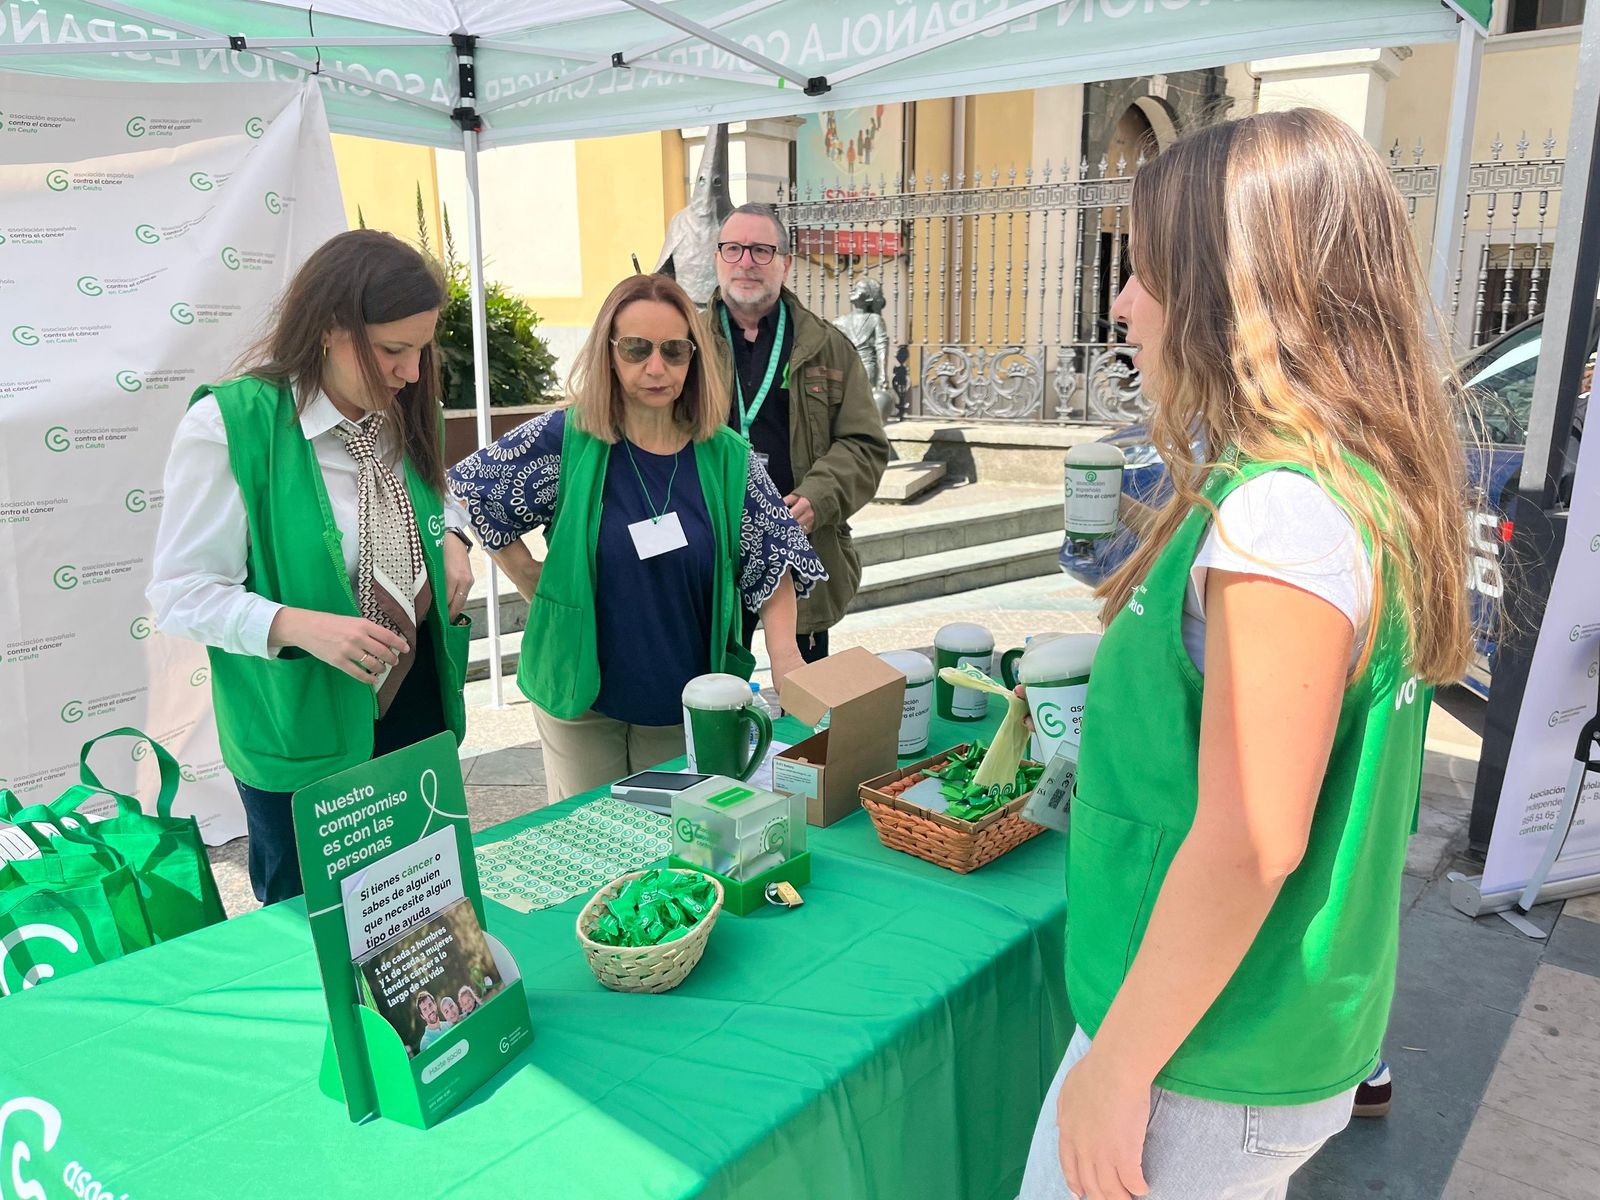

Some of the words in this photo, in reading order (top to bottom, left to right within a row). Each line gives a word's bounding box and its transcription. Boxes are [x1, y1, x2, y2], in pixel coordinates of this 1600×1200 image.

[314, 785, 375, 819] Nuestro
[319, 790, 408, 837] compromiso
[323, 843, 341, 856] es
[344, 826, 371, 847] con
[373, 815, 394, 833] las
[326, 835, 392, 880] personas
[360, 888, 369, 902] Si
[371, 874, 400, 895] tienes
[401, 856, 434, 879] cáncer
[435, 853, 440, 861] o
[362, 896, 390, 918] sabes
[391, 887, 404, 900] de
[406, 869, 440, 893] alguien
[364, 917, 382, 934] que
[385, 894, 424, 922] necesite
[426, 878, 451, 898] algún
[366, 932, 385, 949] tipo
[388, 923, 400, 936] de
[402, 906, 430, 928] ayuda
[379, 978, 385, 988] y
[391, 968, 401, 978] de
[401, 956, 420, 972] cada
[420, 952, 426, 960] 3
[425, 934, 453, 956] mujeres
[381, 961, 391, 972] de
[392, 950, 410, 965] cada
[415, 925, 446, 949] hombres
[383, 974, 410, 996] tendrá
[439, 951, 447, 960] lo
[387, 990, 410, 1008] largo
[410, 982, 420, 993] de
[420, 977, 429, 987] su
[429, 965, 445, 980] vida
